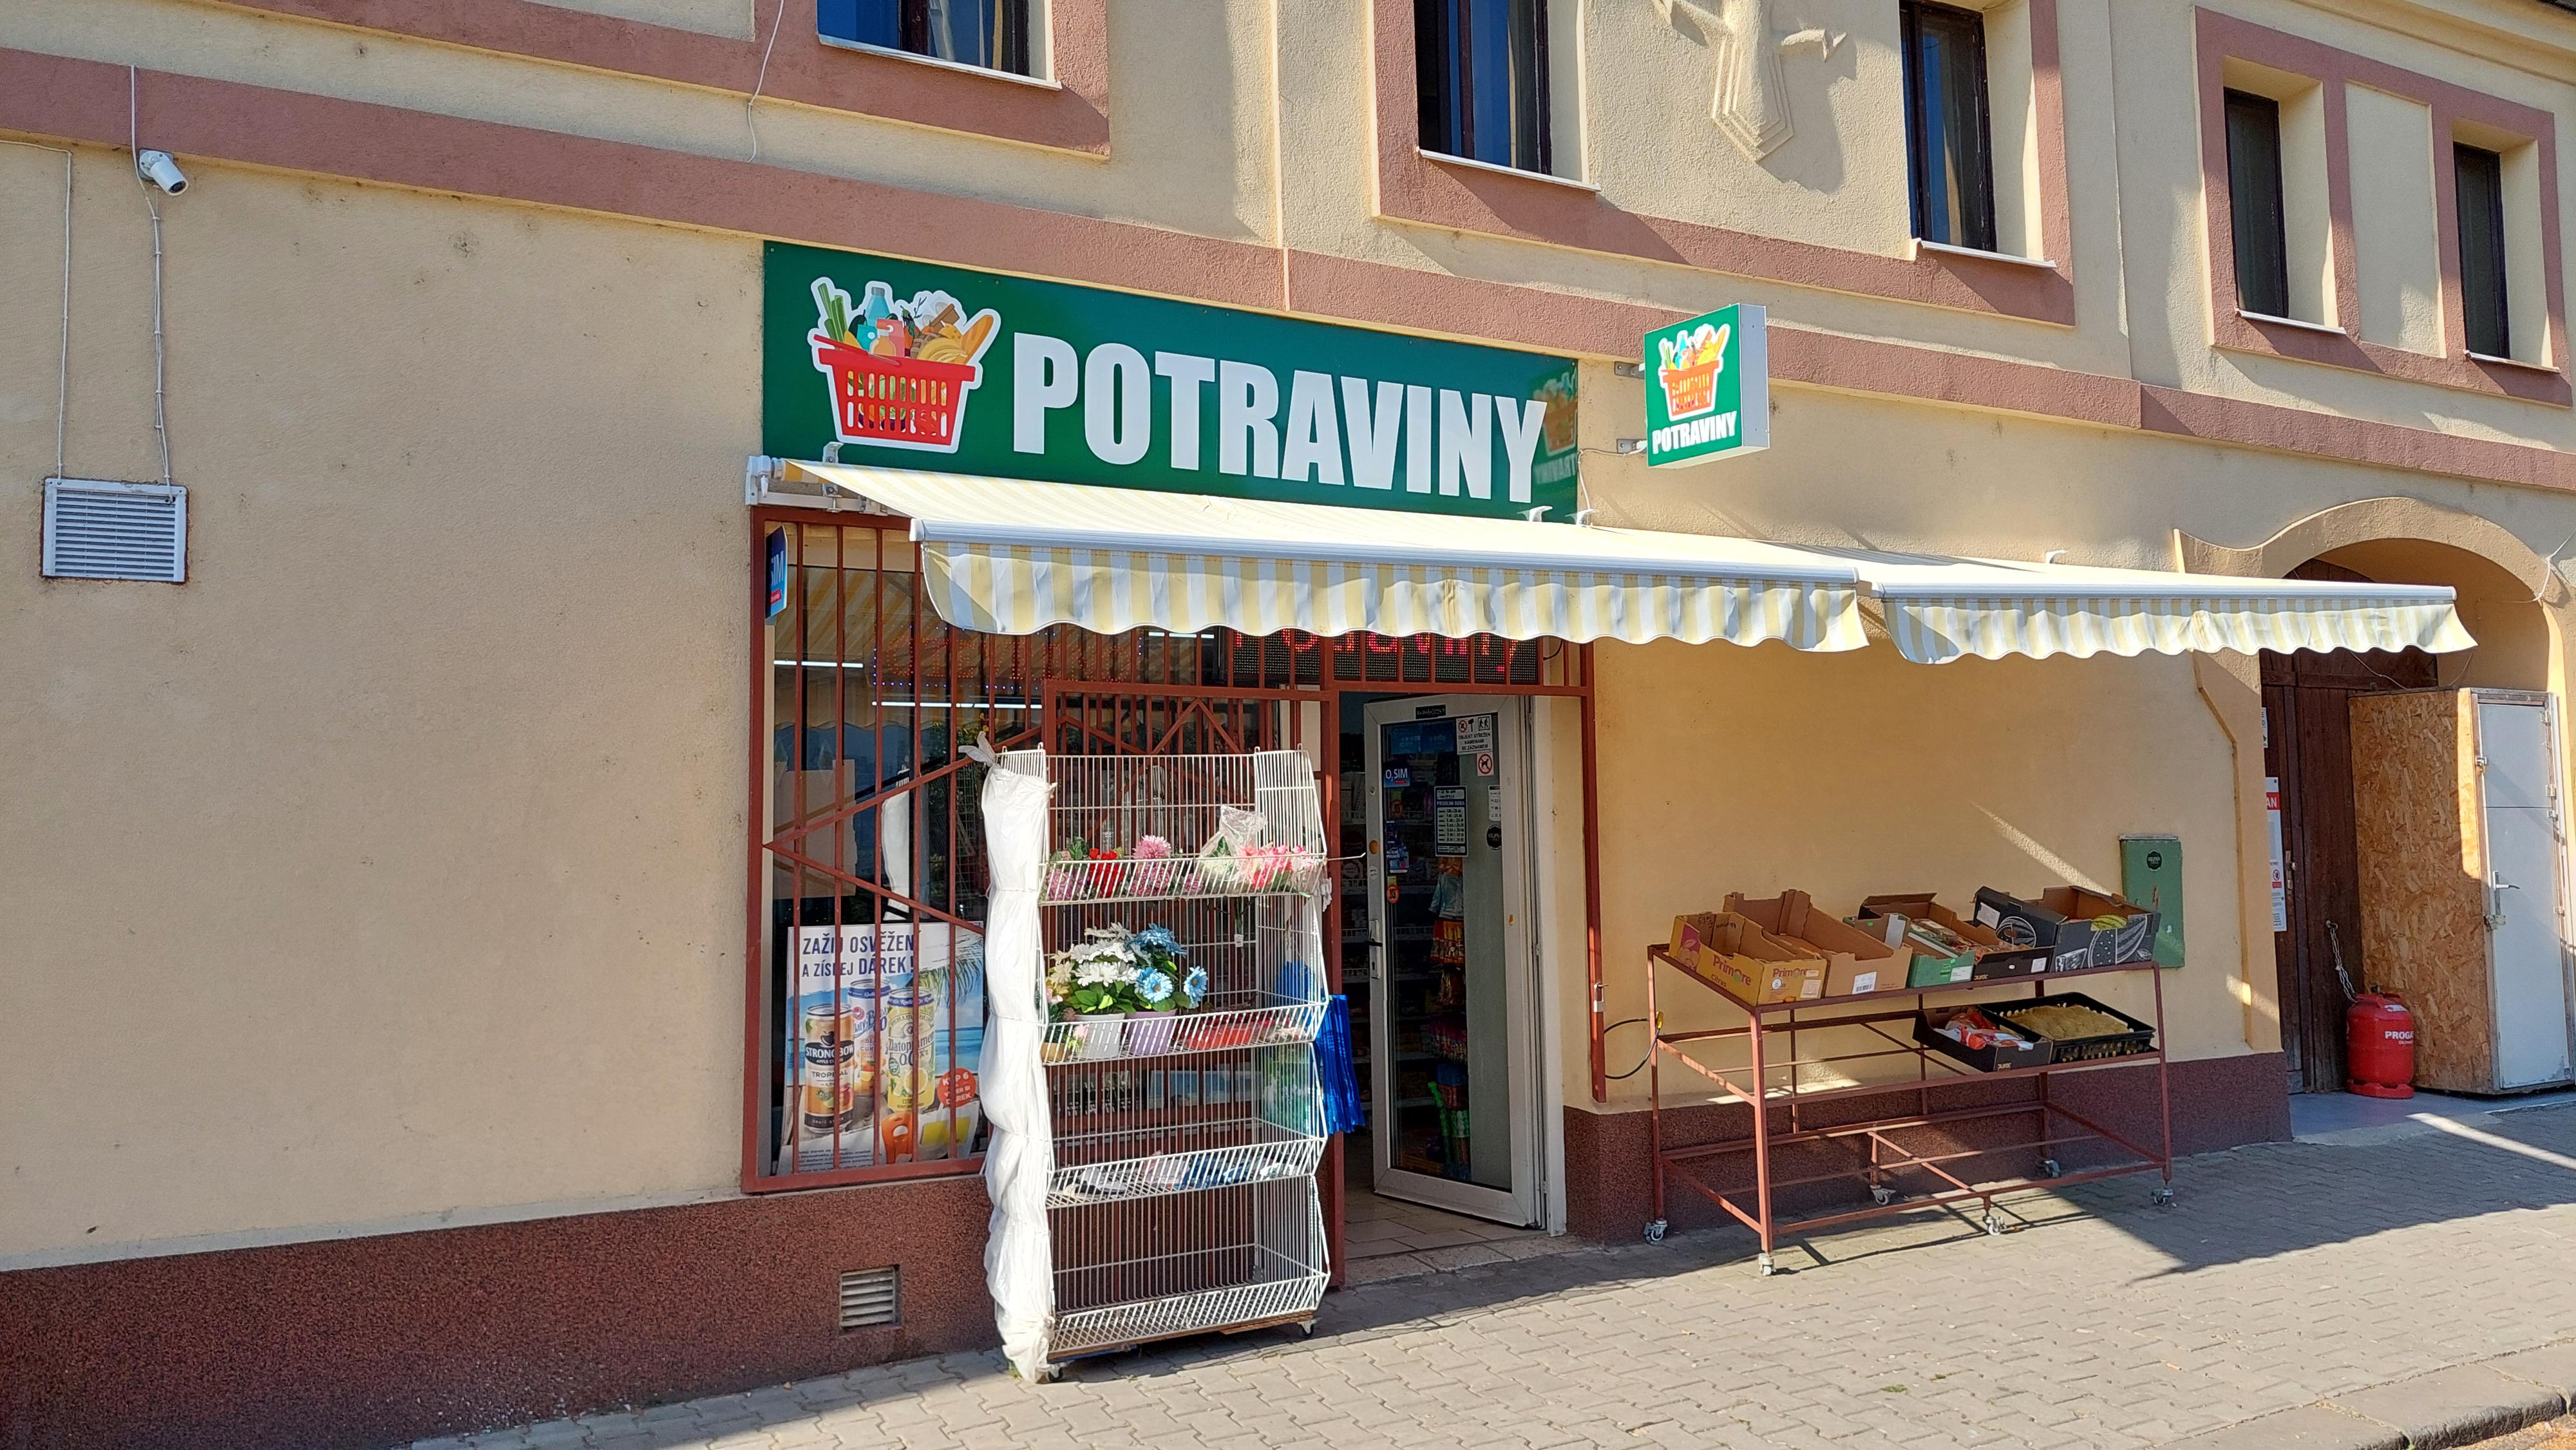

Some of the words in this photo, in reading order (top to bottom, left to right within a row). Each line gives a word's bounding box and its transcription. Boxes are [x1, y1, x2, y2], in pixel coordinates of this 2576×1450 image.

[1013, 332, 1548, 504] POTRAVINY
[1652, 411, 1738, 455] POTRAVINY
[850, 930, 921, 954] OSVĚŽEN
[802, 964, 810, 977] A
[811, 1069, 849, 1078] TROPIAL
[942, 1074, 961, 1086] KP
[963, 1071, 969, 1080] 6
[945, 1092, 972, 1105] DREK
